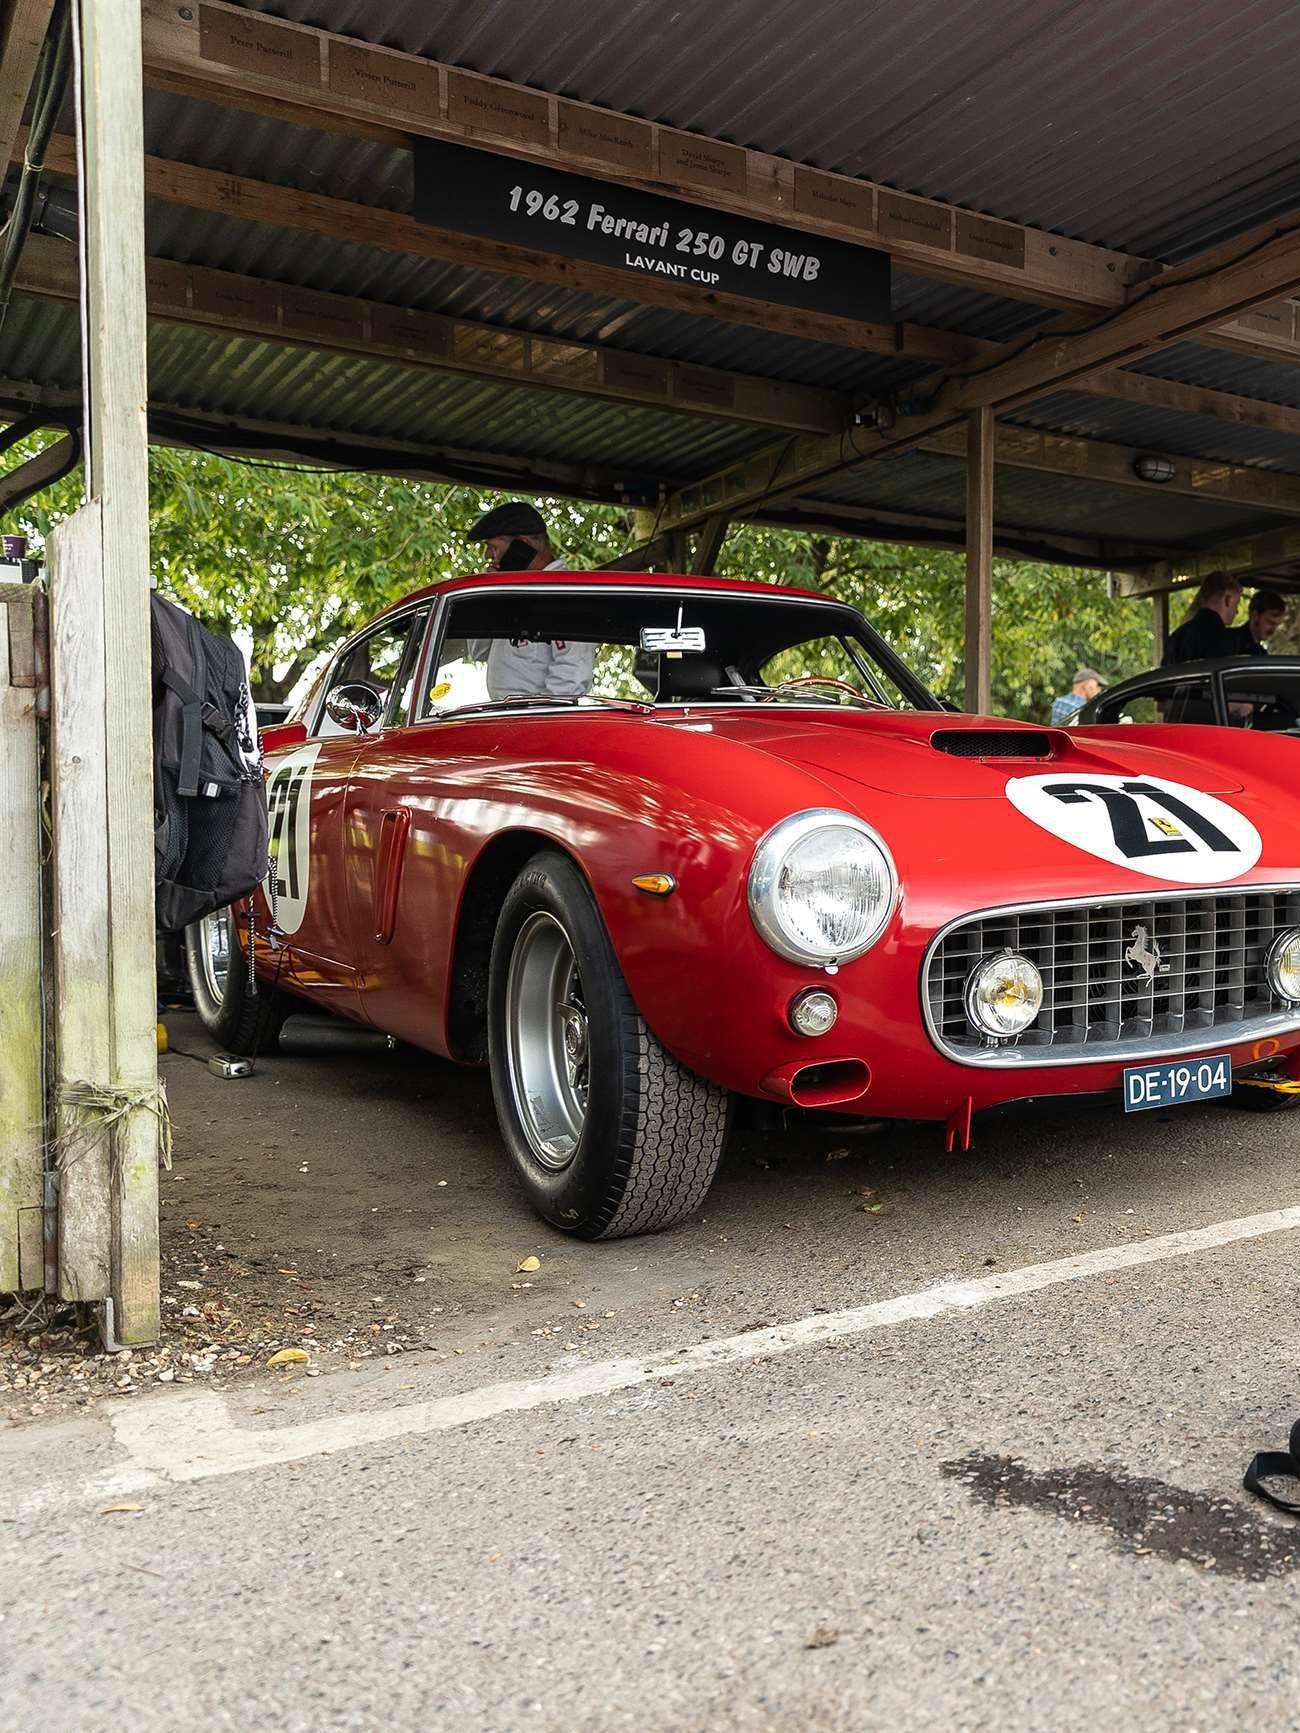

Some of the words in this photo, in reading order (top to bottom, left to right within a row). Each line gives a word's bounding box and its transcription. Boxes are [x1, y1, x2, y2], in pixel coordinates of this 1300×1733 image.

[230, 34, 253, 49] Peter
[509, 185, 580, 226] 1962
[587, 203, 669, 248] Ferrari
[675, 228, 725, 260] 250
[732, 239, 764, 269] GT
[767, 248, 821, 281] SWB
[625, 253, 687, 277] LAVANT
[690, 268, 720, 285] CUP
[268, 766, 308, 900] 21
[1041, 782, 1241, 858] 21
[1129, 1061, 1227, 1104] DE-19-04
